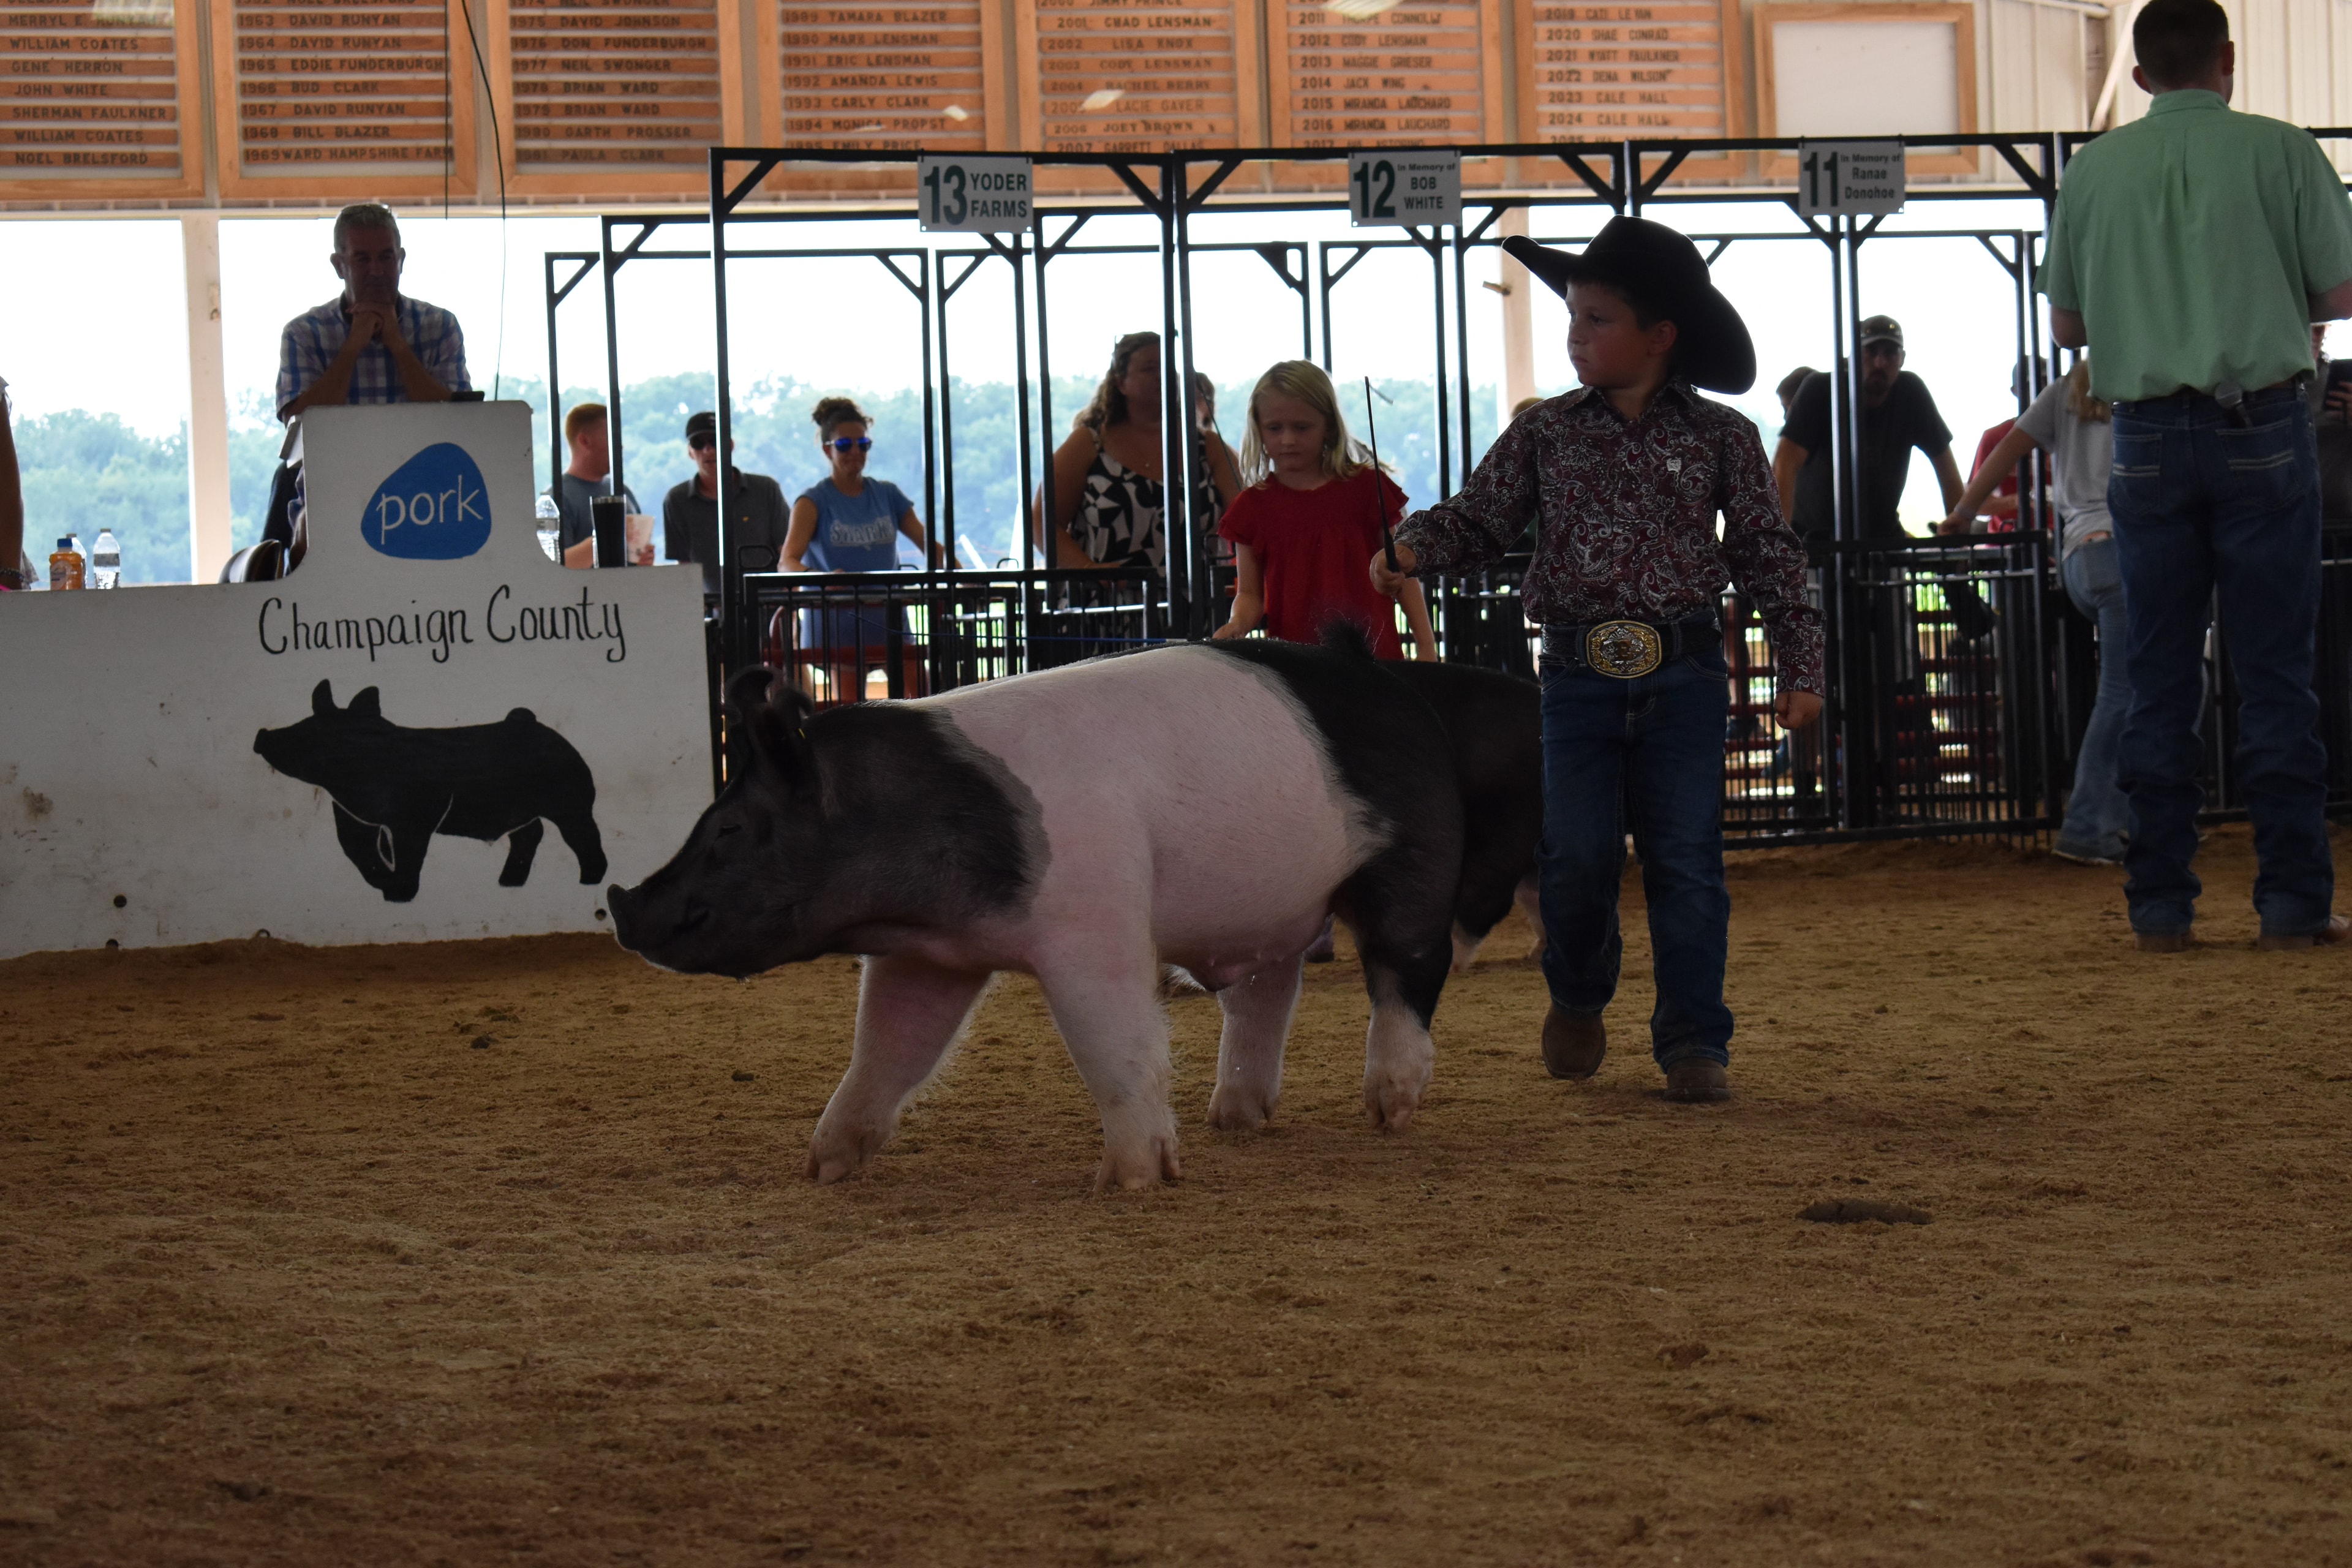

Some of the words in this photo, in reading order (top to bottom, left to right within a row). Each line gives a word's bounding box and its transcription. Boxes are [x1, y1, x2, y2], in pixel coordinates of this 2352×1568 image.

[785, 11, 818, 23] 1989
[829, 11, 882, 23] TAMARA
[894, 11, 946, 23] BLAZER
[1299, 12, 1325, 23] 2011
[1545, 8, 1575, 20] 2019
[9, 15, 67, 26] MERRYL
[240, 15, 274, 26] 1963
[290, 15, 332, 26] DAVID
[342, 15, 401, 26] RUNYAN
[512, 17, 546, 28] 1975
[560, 17, 603, 28] DAVID
[617, 17, 680, 28] JOHNSON
[1057, 17, 1087, 28] 2001
[1105, 17, 1139, 28] CHAD
[1148, 17, 1212, 28] LENSMAN
[786, 34, 820, 44] 1990
[875, 34, 938, 44] LENSMAN
[1547, 29, 1581, 40] 2020
[1592, 29, 1617, 40] SHAE
[1629, 29, 1669, 40] CONRAD
[10, 39, 69, 50] WILLIAM
[81, 39, 138, 50] COATES
[241, 37, 274, 48] 1964
[291, 37, 333, 48] DAVID
[344, 37, 401, 48] RUNYAN
[513, 37, 547, 48] 1976
[562, 37, 590, 48] DON
[605, 37, 706, 48] FUNDERBURGH
[1049, 39, 1082, 49] 2002
[1113, 39, 1144, 49] LISA
[1158, 39, 1192, 49] KNOX
[1300, 34, 1330, 47] 2012
[1341, 34, 1366, 47] CODY
[1379, 34, 1427, 47] LENSMAN
[787, 55, 816, 66] 1991
[827, 55, 857, 66] ERIC
[867, 55, 931, 66] LENSMAN
[1547, 50, 1578, 61] 2021
[1589, 50, 1618, 61] WYATT
[1629, 50, 1679, 61] FAULKNER
[12, 61, 50, 73] GENE
[66, 61, 123, 73] HERRON
[242, 59, 276, 71] 1965
[292, 59, 332, 71] EDDIE
[341, 59, 443, 71] FUNDERBURGH
[514, 60, 547, 71] 1977
[562, 60, 592, 71] NEIL
[604, 60, 671, 71] SWONGER
[1100, 59, 1133, 70] CODY
[1145, 59, 1212, 70] LENSMAN
[1300, 56, 1331, 68] 2013
[1343, 56, 1379, 68] MAGGIE
[1391, 56, 1432, 68] GRIESER
[788, 76, 820, 86] 1992
[831, 76, 886, 86] AMANDA
[897, 76, 938, 86] LEWIS
[1547, 70, 1581, 82] 2022
[1593, 70, 1619, 82] DENA
[1630, 70, 1666, 82] WILSON
[243, 82, 277, 93] 1966
[292, 82, 320, 93] BUD
[334, 82, 379, 93] CLARK
[515, 83, 548, 93] 1978
[564, 83, 605, 93] BRIAN
[620, 83, 659, 93] WARD
[1052, 80, 1083, 90] 2004
[1106, 80, 1160, 90] RACHEL
[1167, 80, 1210, 90] BERRY
[1301, 77, 1331, 88] 2014
[1344, 77, 1369, 88] JACK
[1382, 77, 1405, 88] WING
[15, 85, 52, 96] JOHN
[64, 85, 108, 96] WHITE
[789, 97, 821, 108] 1993
[832, 97, 875, 108] CARLY
[887, 97, 929, 108] CLARK
[1549, 91, 1581, 103] 2023
[1596, 91, 1625, 103] CALE
[1639, 91, 1668, 103] HALL
[1117, 99, 1152, 113] LACIE
[1161, 99, 1204, 113] GAVER
[1302, 98, 1333, 109] 2015
[1344, 98, 1387, 109] MIRANDA
[13, 108, 81, 118] SHERMAN
[92, 108, 166, 118] FAULKNER
[244, 105, 277, 115] 1967
[294, 105, 336, 115] DAVID
[347, 105, 405, 115] RUNYAN
[516, 104, 550, 115] 1979
[565, 104, 606, 115] BRIAN
[622, 104, 660, 115] WARD
[790, 119, 822, 129] 1994
[894, 119, 946, 129] PROPST
[1303, 119, 1333, 130] 2016
[1344, 119, 1386, 130] MIRANDA
[1549, 113, 1582, 125] 2024
[1597, 113, 1626, 125] CALE
[1638, 113, 1669, 125] HALL
[244, 127, 278, 138] 1968
[293, 127, 323, 138] BILL
[336, 127, 390, 138] BLAZER
[517, 127, 550, 137] 1980
[566, 127, 611, 137] GARTH
[627, 127, 690, 137] PROSSER
[1055, 122, 1087, 134] 2006
[1104, 122, 1137, 134] JOEY
[1144, 122, 1193, 134] BROWN
[15, 130, 75, 141] WILLIAM
[87, 130, 143, 141] COATES
[1057, 141, 1092, 153] 2007
[16, 153, 53, 164] NOEL
[64, 153, 148, 164] BRELSFORD
[246, 148, 279, 160] 1969
[282, 148, 321, 160] WARD
[330, 148, 408, 160] HAMPSHIRE
[416, 148, 453, 160] FARM
[620, 149, 665, 161] CLARK
[1852, 154, 1888, 163] Memory
[1803, 152, 1838, 206] 11
[1853, 168, 1887, 179] Ranae
[971, 174, 1026, 191] YODER
[1411, 178, 1436, 189] BOB
[1354, 160, 1395, 218] 12
[1845, 187, 1894, 199] Donohoe
[924, 165, 967, 225] 13
[971, 200, 1027, 217] FARMS
[1404, 197, 1442, 209] WHITE
[377, 475, 483, 545] pork
[258, 597, 473, 663] Champaign
[488, 585, 627, 663] County
